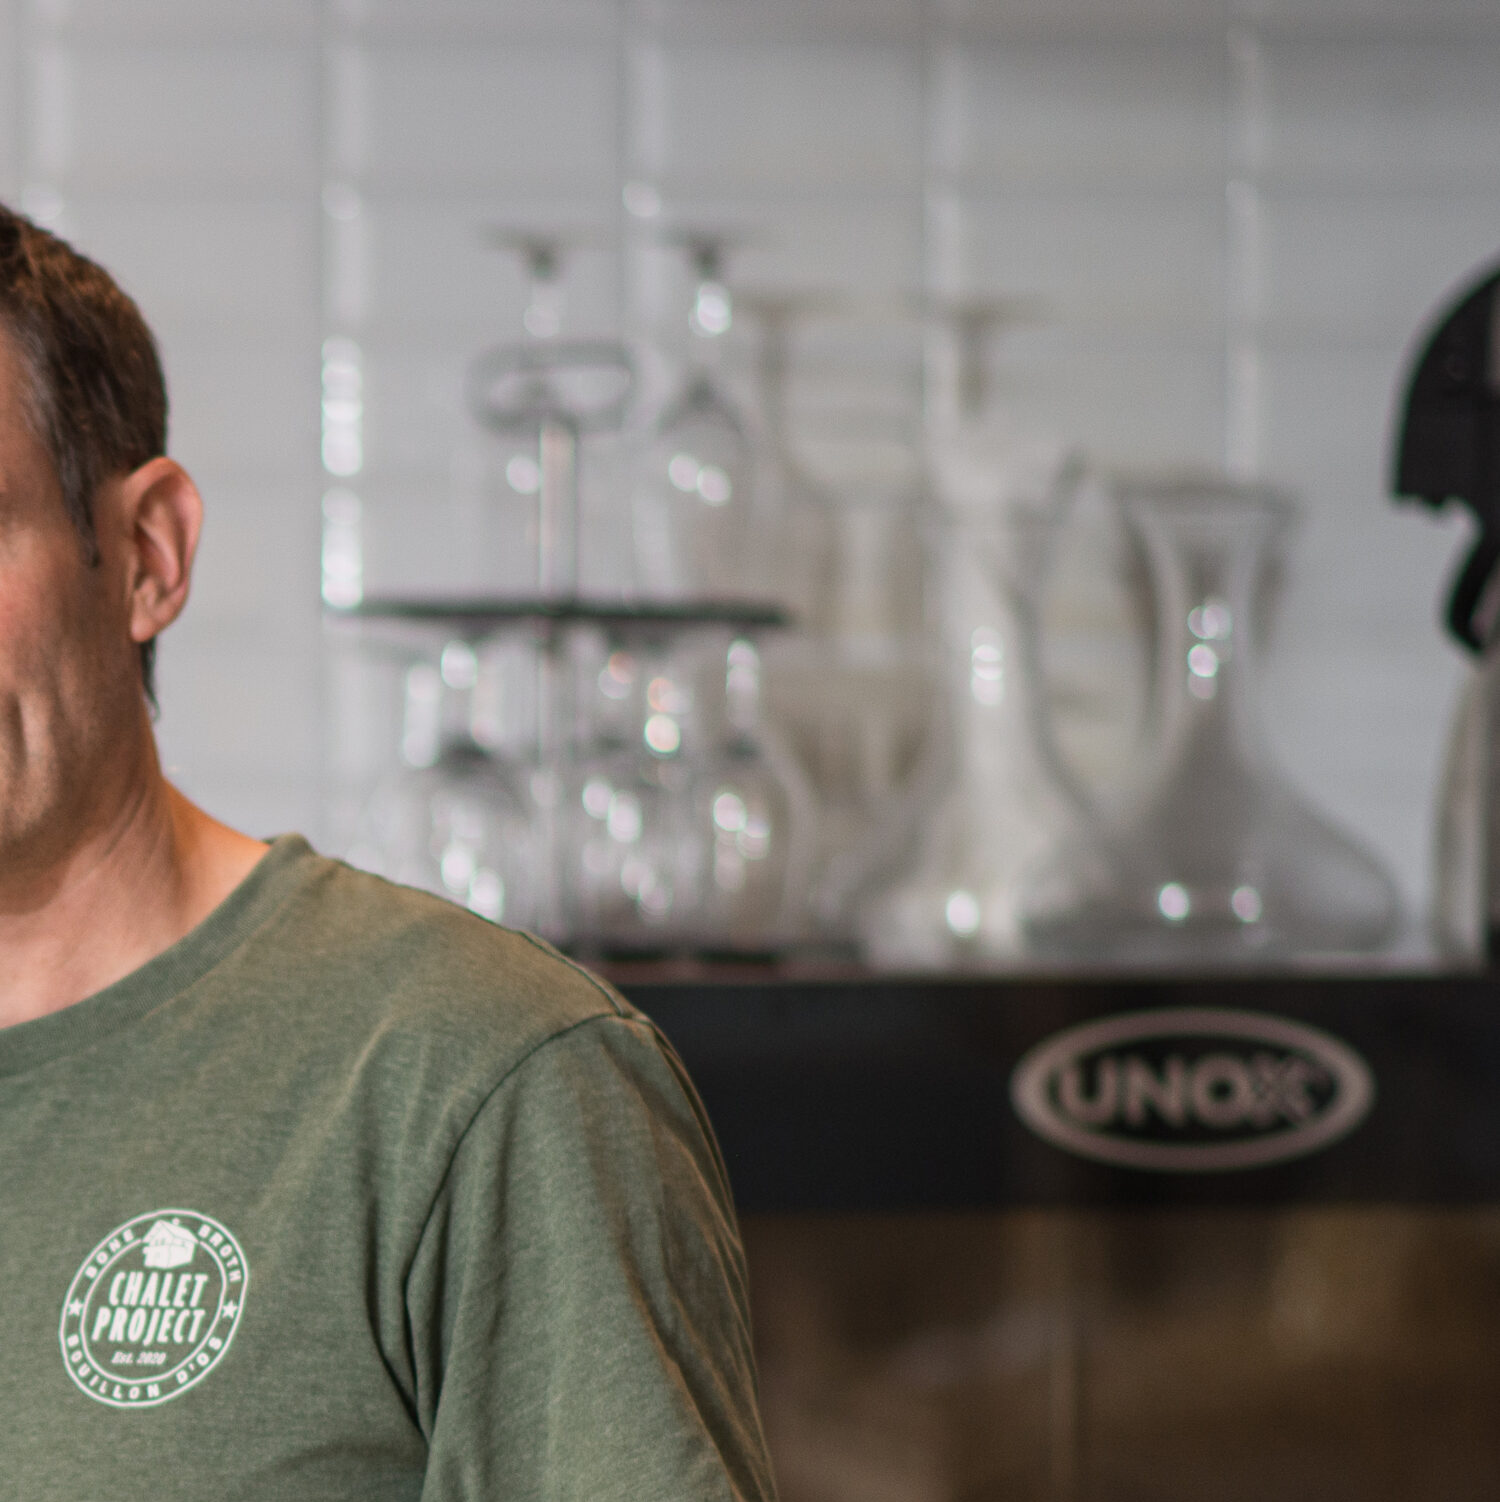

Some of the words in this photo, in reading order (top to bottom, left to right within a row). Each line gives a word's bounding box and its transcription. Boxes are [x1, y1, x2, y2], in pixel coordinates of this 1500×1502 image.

[1058, 1052, 1330, 1128] UNOX
[85, 1228, 135, 1279] BONE
[198, 1224, 242, 1282] BROTH
[109, 1271, 208, 1308] CHALET
[91, 1306, 206, 1347] PROJECT
[67, 1334, 160, 1400] BOUILLON
[176, 1337, 223, 1384] D'OS
[111, 1351, 133, 1364] Est.
